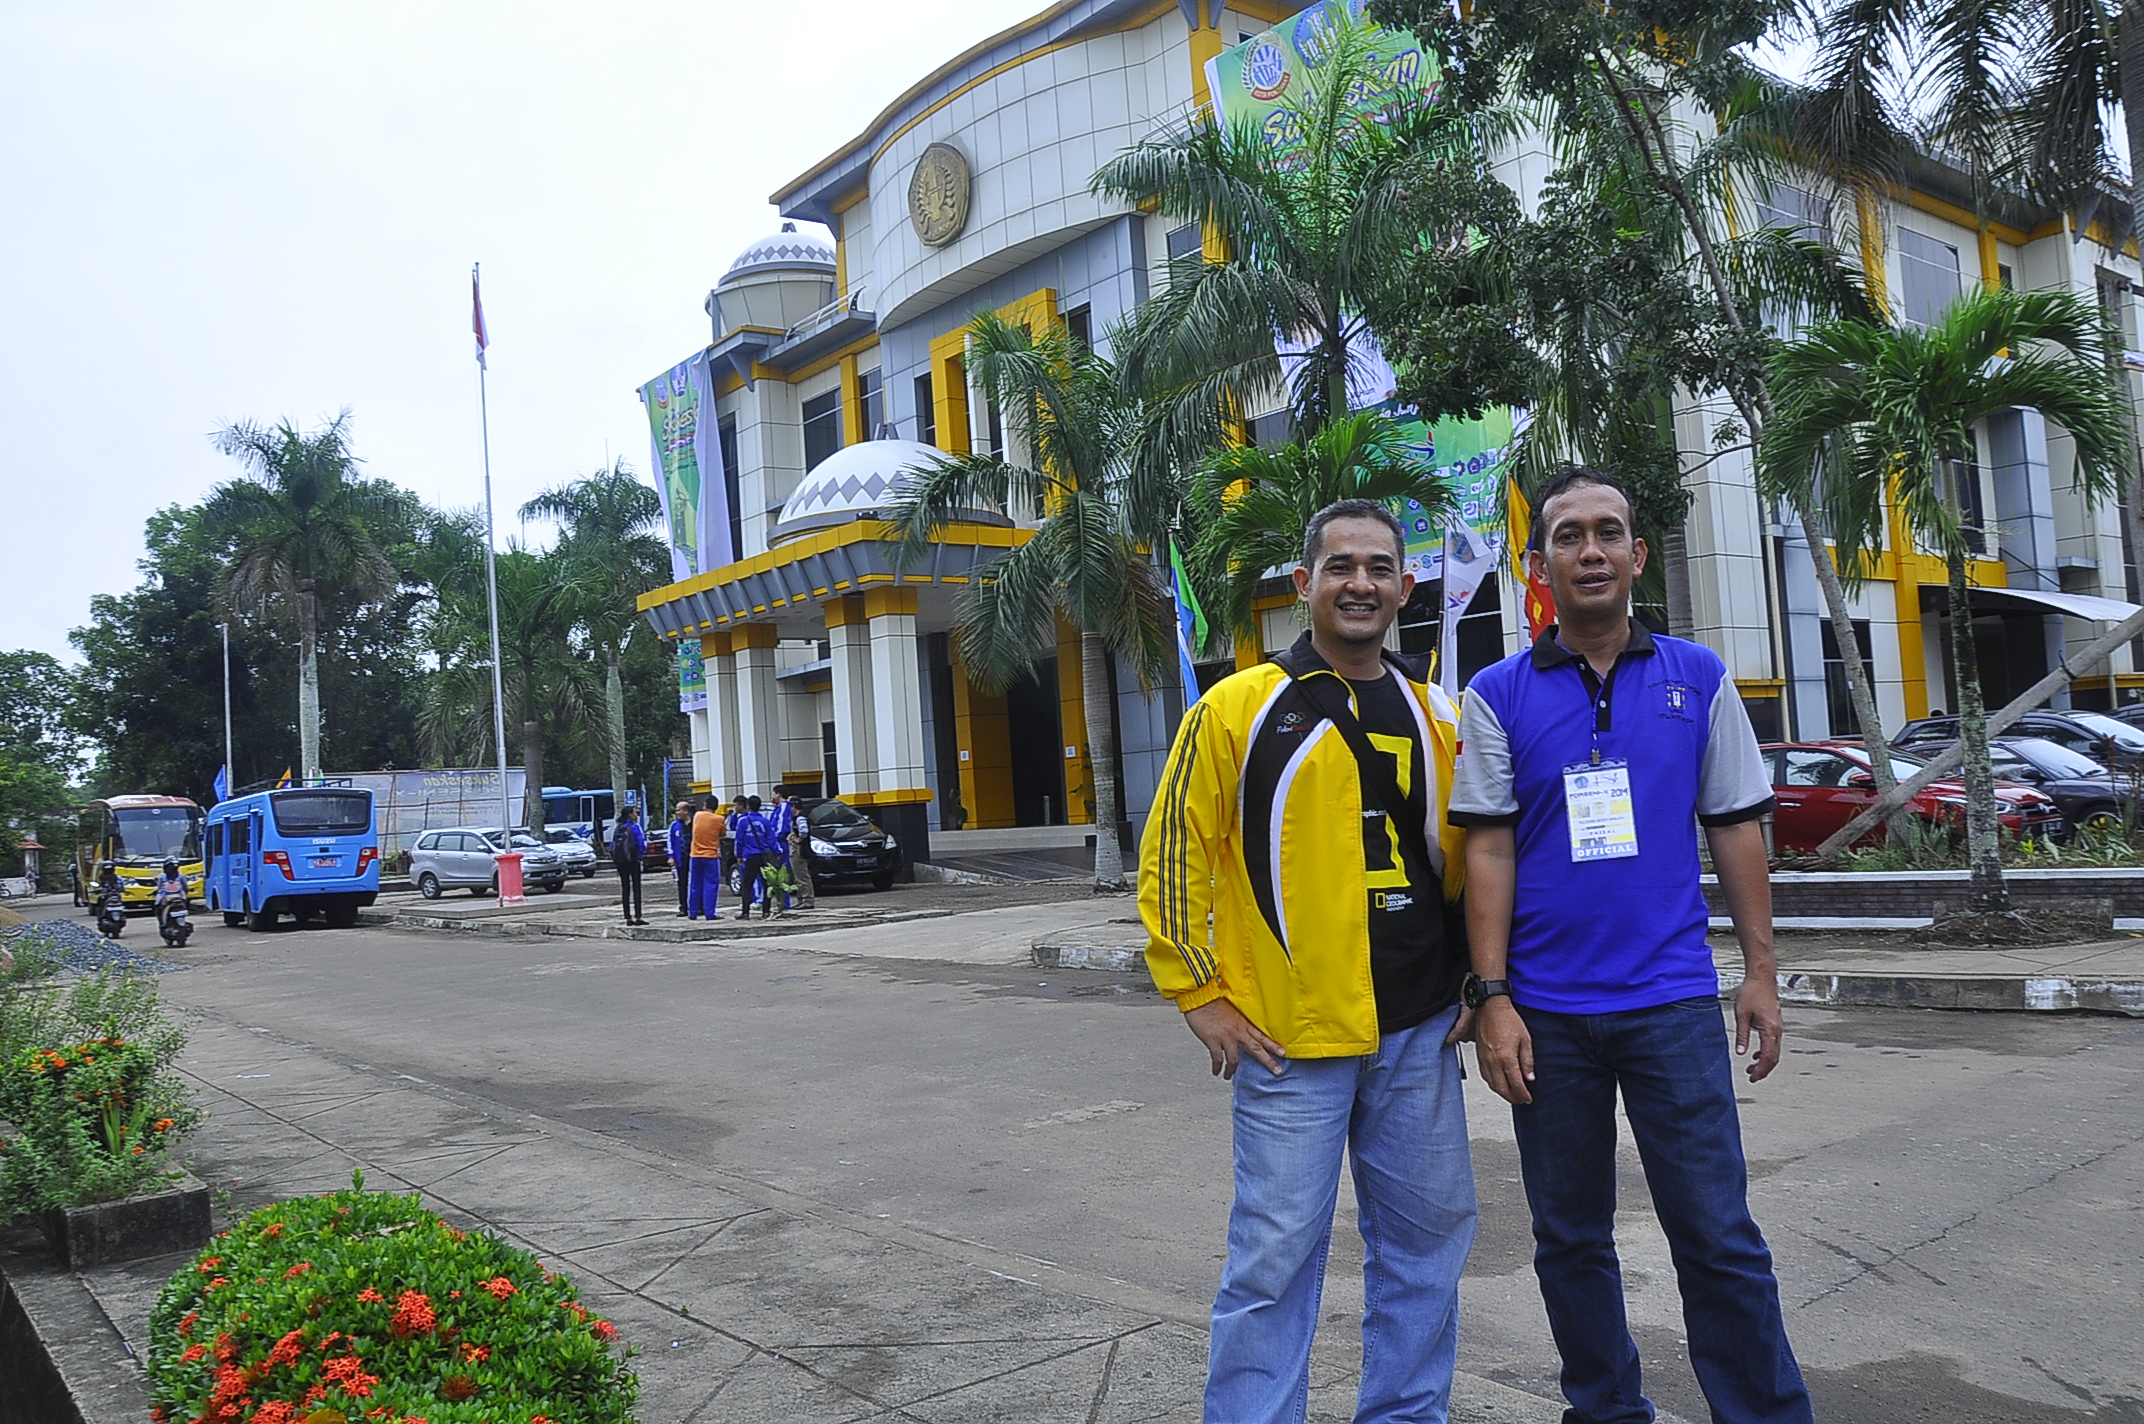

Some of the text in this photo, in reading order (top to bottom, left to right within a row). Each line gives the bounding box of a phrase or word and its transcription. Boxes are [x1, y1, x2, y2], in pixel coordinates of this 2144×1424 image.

[626, 791, 633, 799] P
[1610, 787, 1628, 798] 2014
[1577, 844, 1632, 857] OFFICIAL
